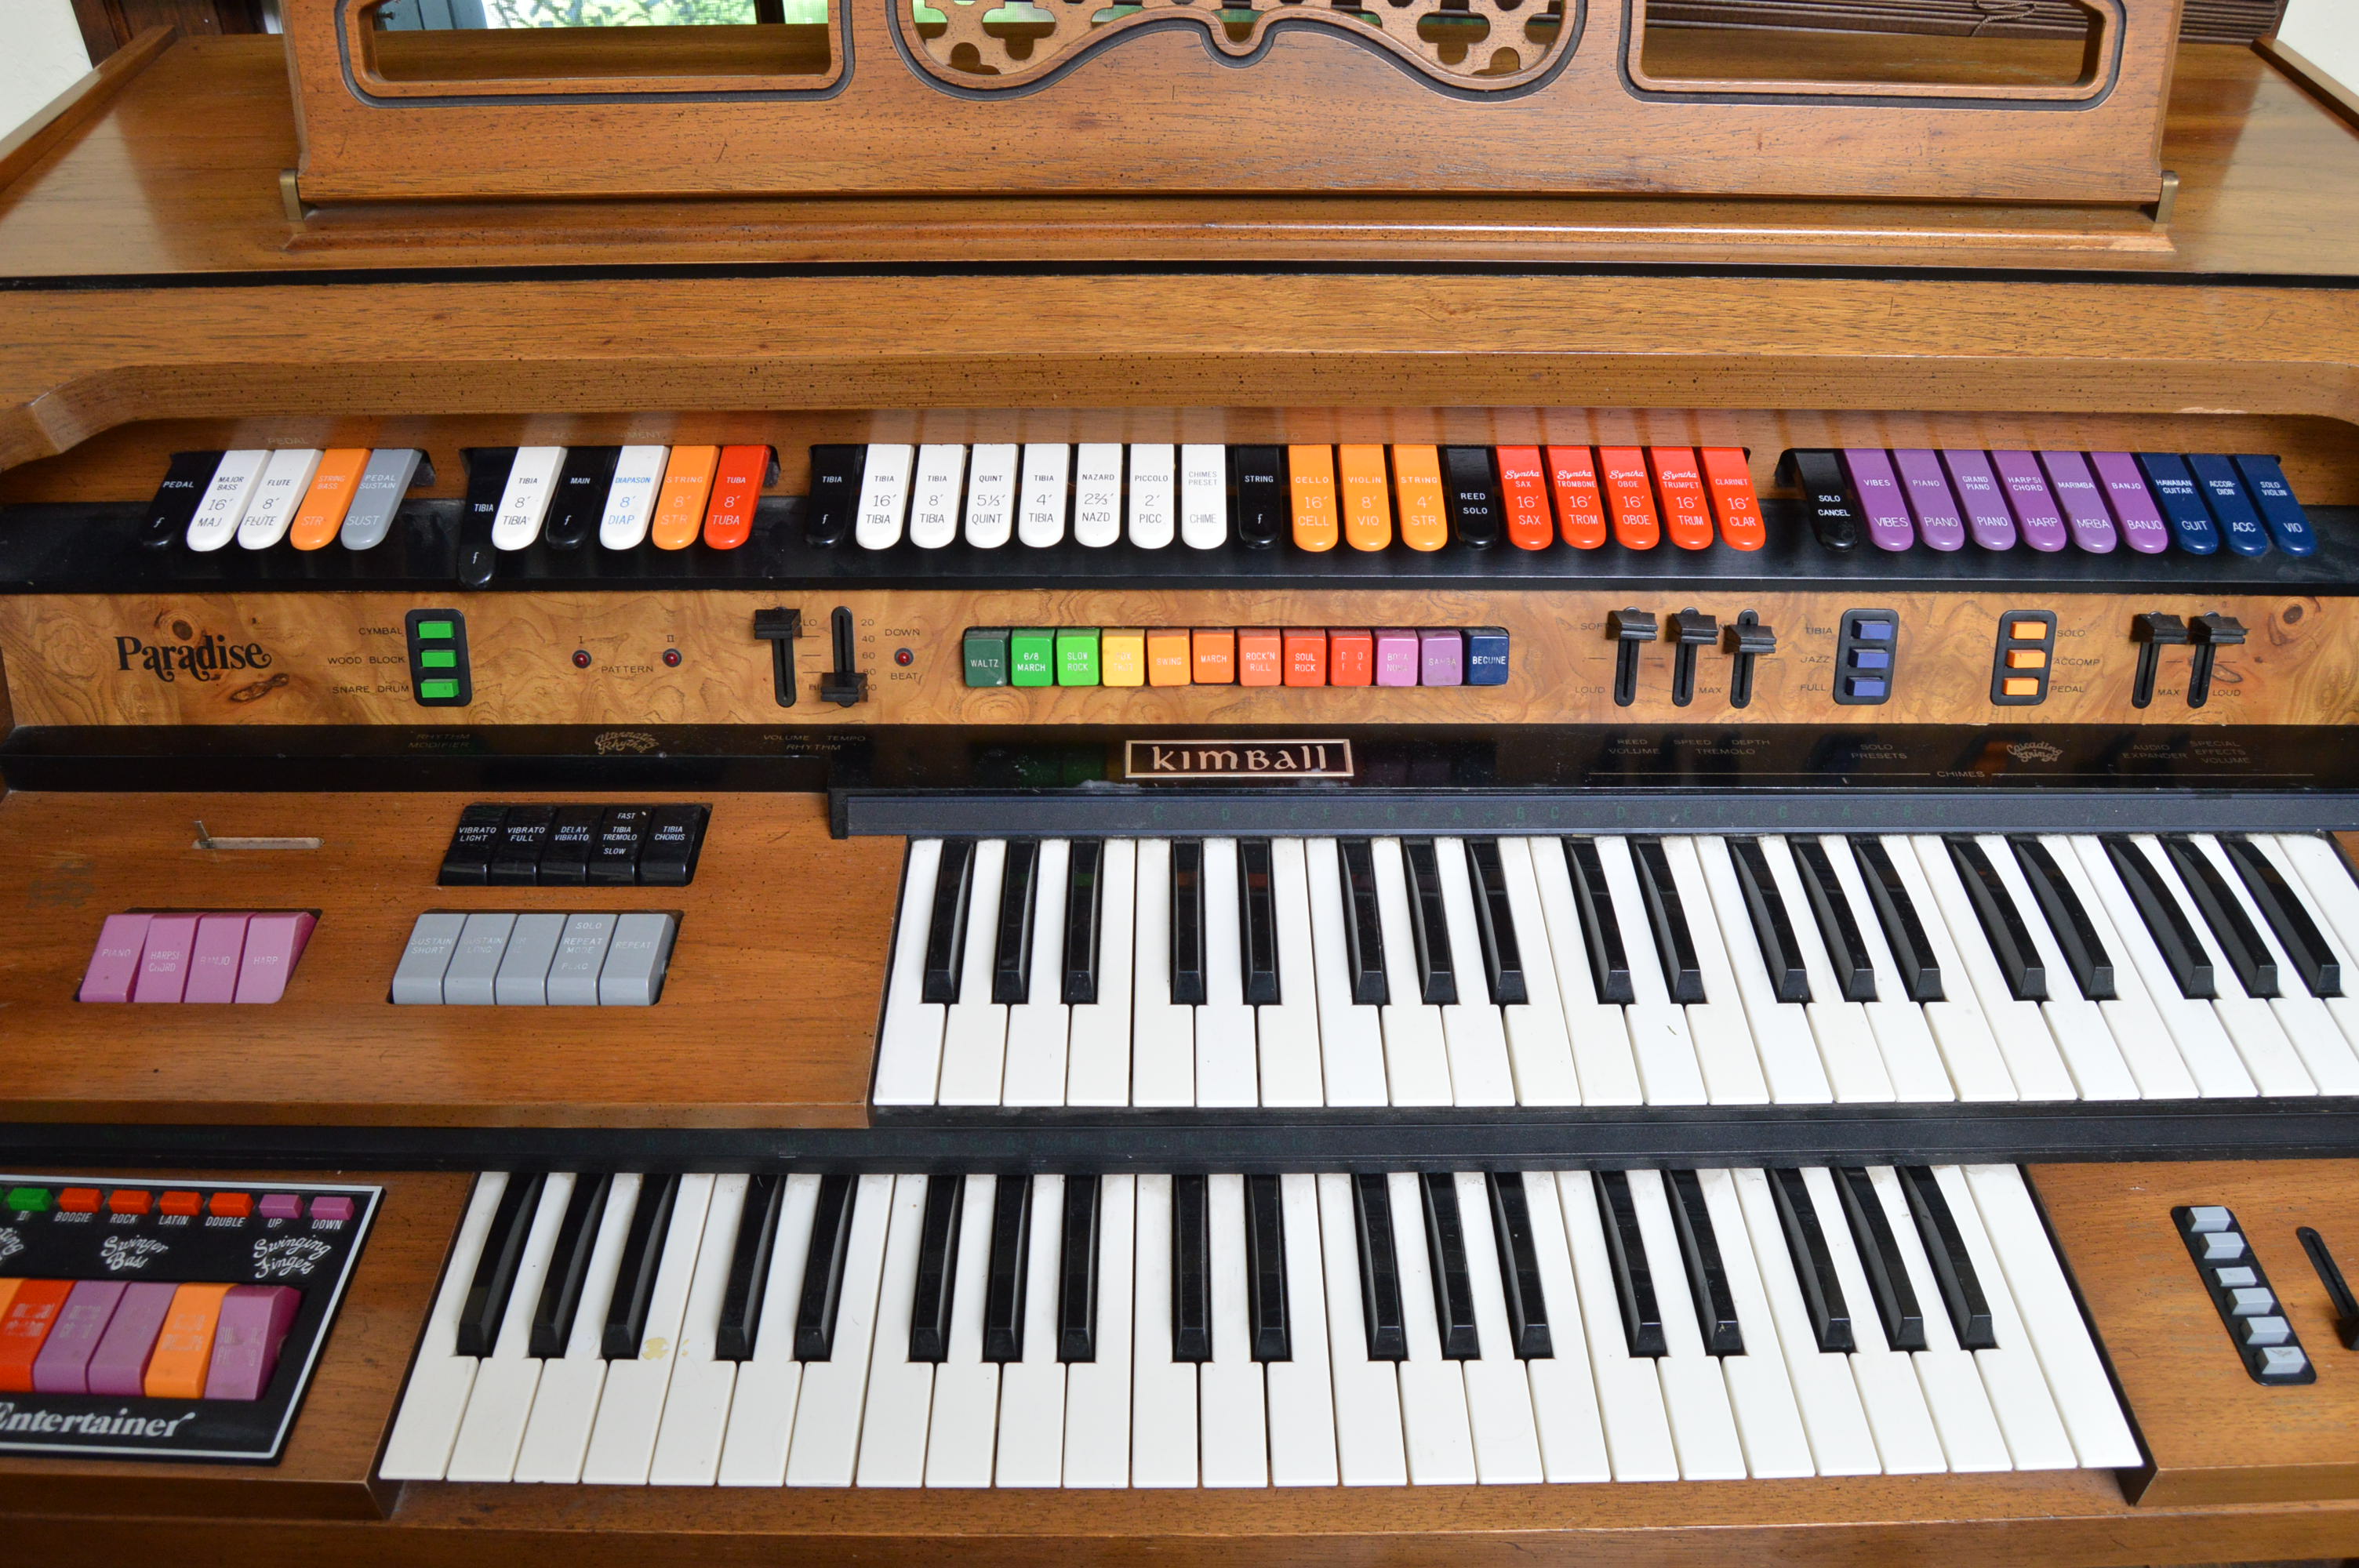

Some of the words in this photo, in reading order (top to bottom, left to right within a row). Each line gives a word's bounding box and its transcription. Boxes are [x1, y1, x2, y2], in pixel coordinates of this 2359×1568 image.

[1504, 470, 1540, 479] Syntha
[1557, 470, 1592, 479] Syntha
[1609, 470, 1645, 479] Syntha
[1662, 470, 1697, 480] Syntha
[474, 503, 494, 512] TIBIA
[198, 517, 222, 527] MAJ
[347, 516, 380, 526] SUST
[608, 515, 635, 525] DIAP
[712, 515, 740, 525] TUBA
[1081, 512, 1110, 522] NAZD
[1139, 514, 1162, 524] PICC
[1190, 514, 1216, 524] CHIME
[1298, 516, 1329, 526] CELL
[1568, 514, 1598, 525] TROM
[1677, 515, 1703, 525] TRUM
[1730, 517, 1756, 527] CLAR
[2026, 517, 2058, 528] HARP
[2077, 519, 2110, 529] MRBA
[2182, 521, 2208, 531] GUIT
[2233, 522, 2255, 532] ACC
[116, 635, 272, 682] Paradise
[54, 1212, 93, 1223] BOOGIE
[110, 1214, 136, 1224] ROCK
[158, 1215, 188, 1225] LATIN
[205, 1217, 245, 1227] DOUBLE
[267, 1218, 282, 1228] UP
[311, 1219, 343, 1230] DOWN
[253, 1234, 332, 1259] Swinging
[106, 1251, 149, 1271] Bass
